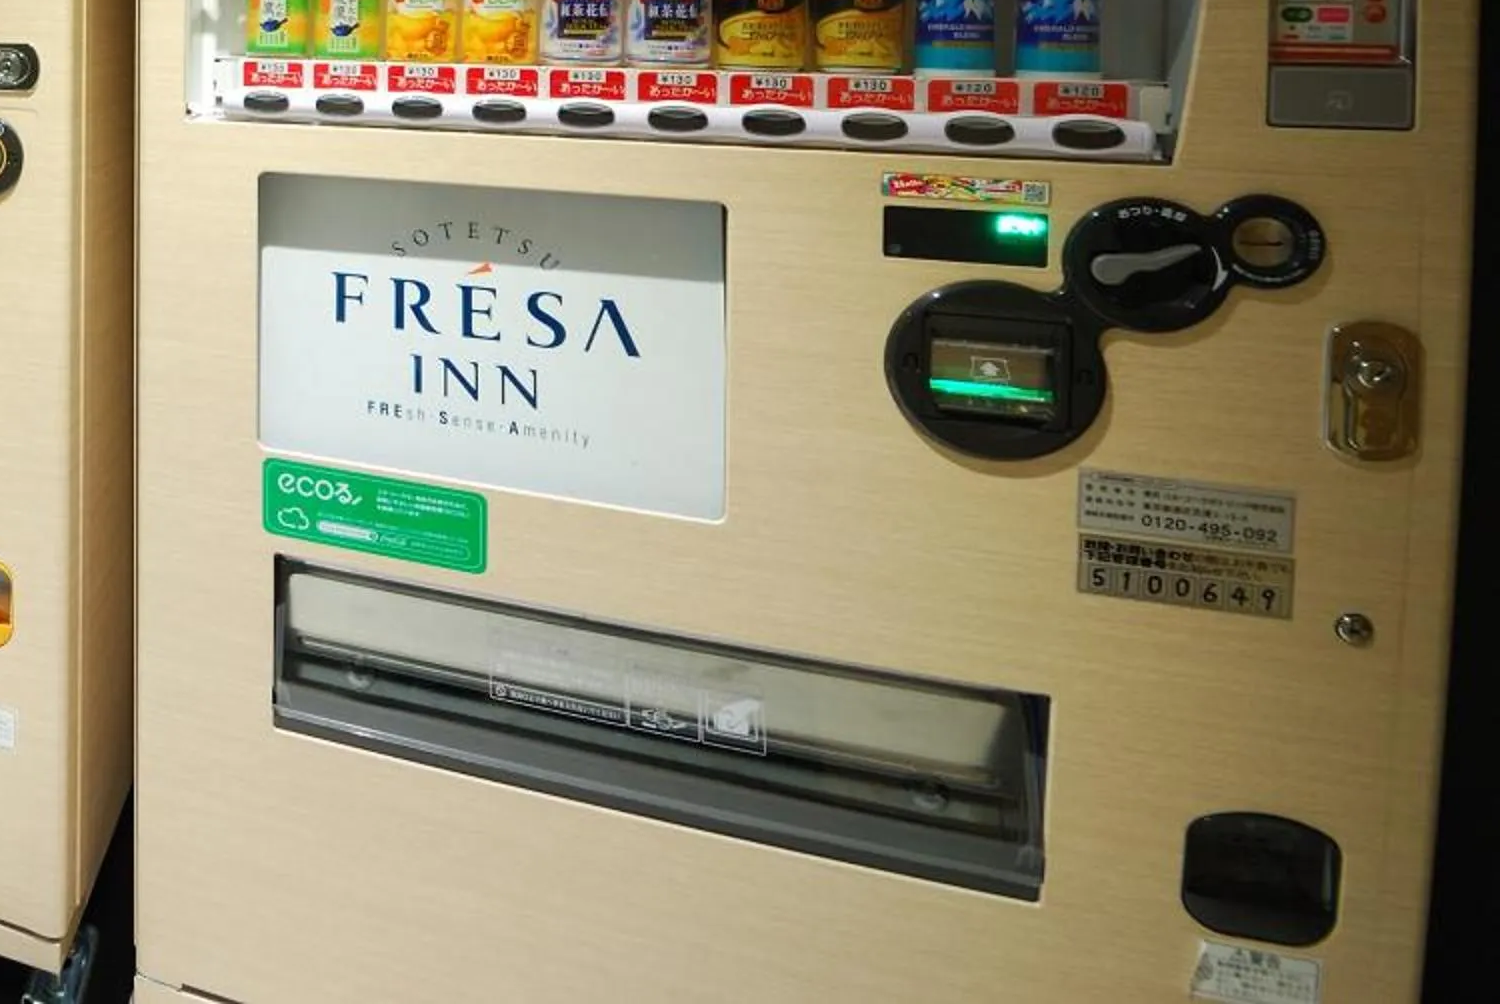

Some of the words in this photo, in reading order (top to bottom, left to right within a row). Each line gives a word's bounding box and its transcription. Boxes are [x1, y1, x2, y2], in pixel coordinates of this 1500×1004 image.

[391, 220, 560, 271] SOTETSU
[410, 353, 538, 410] INN
[508, 420, 592, 449] Amenity
[1140, 514, 1278, 542] 0120-495-092
